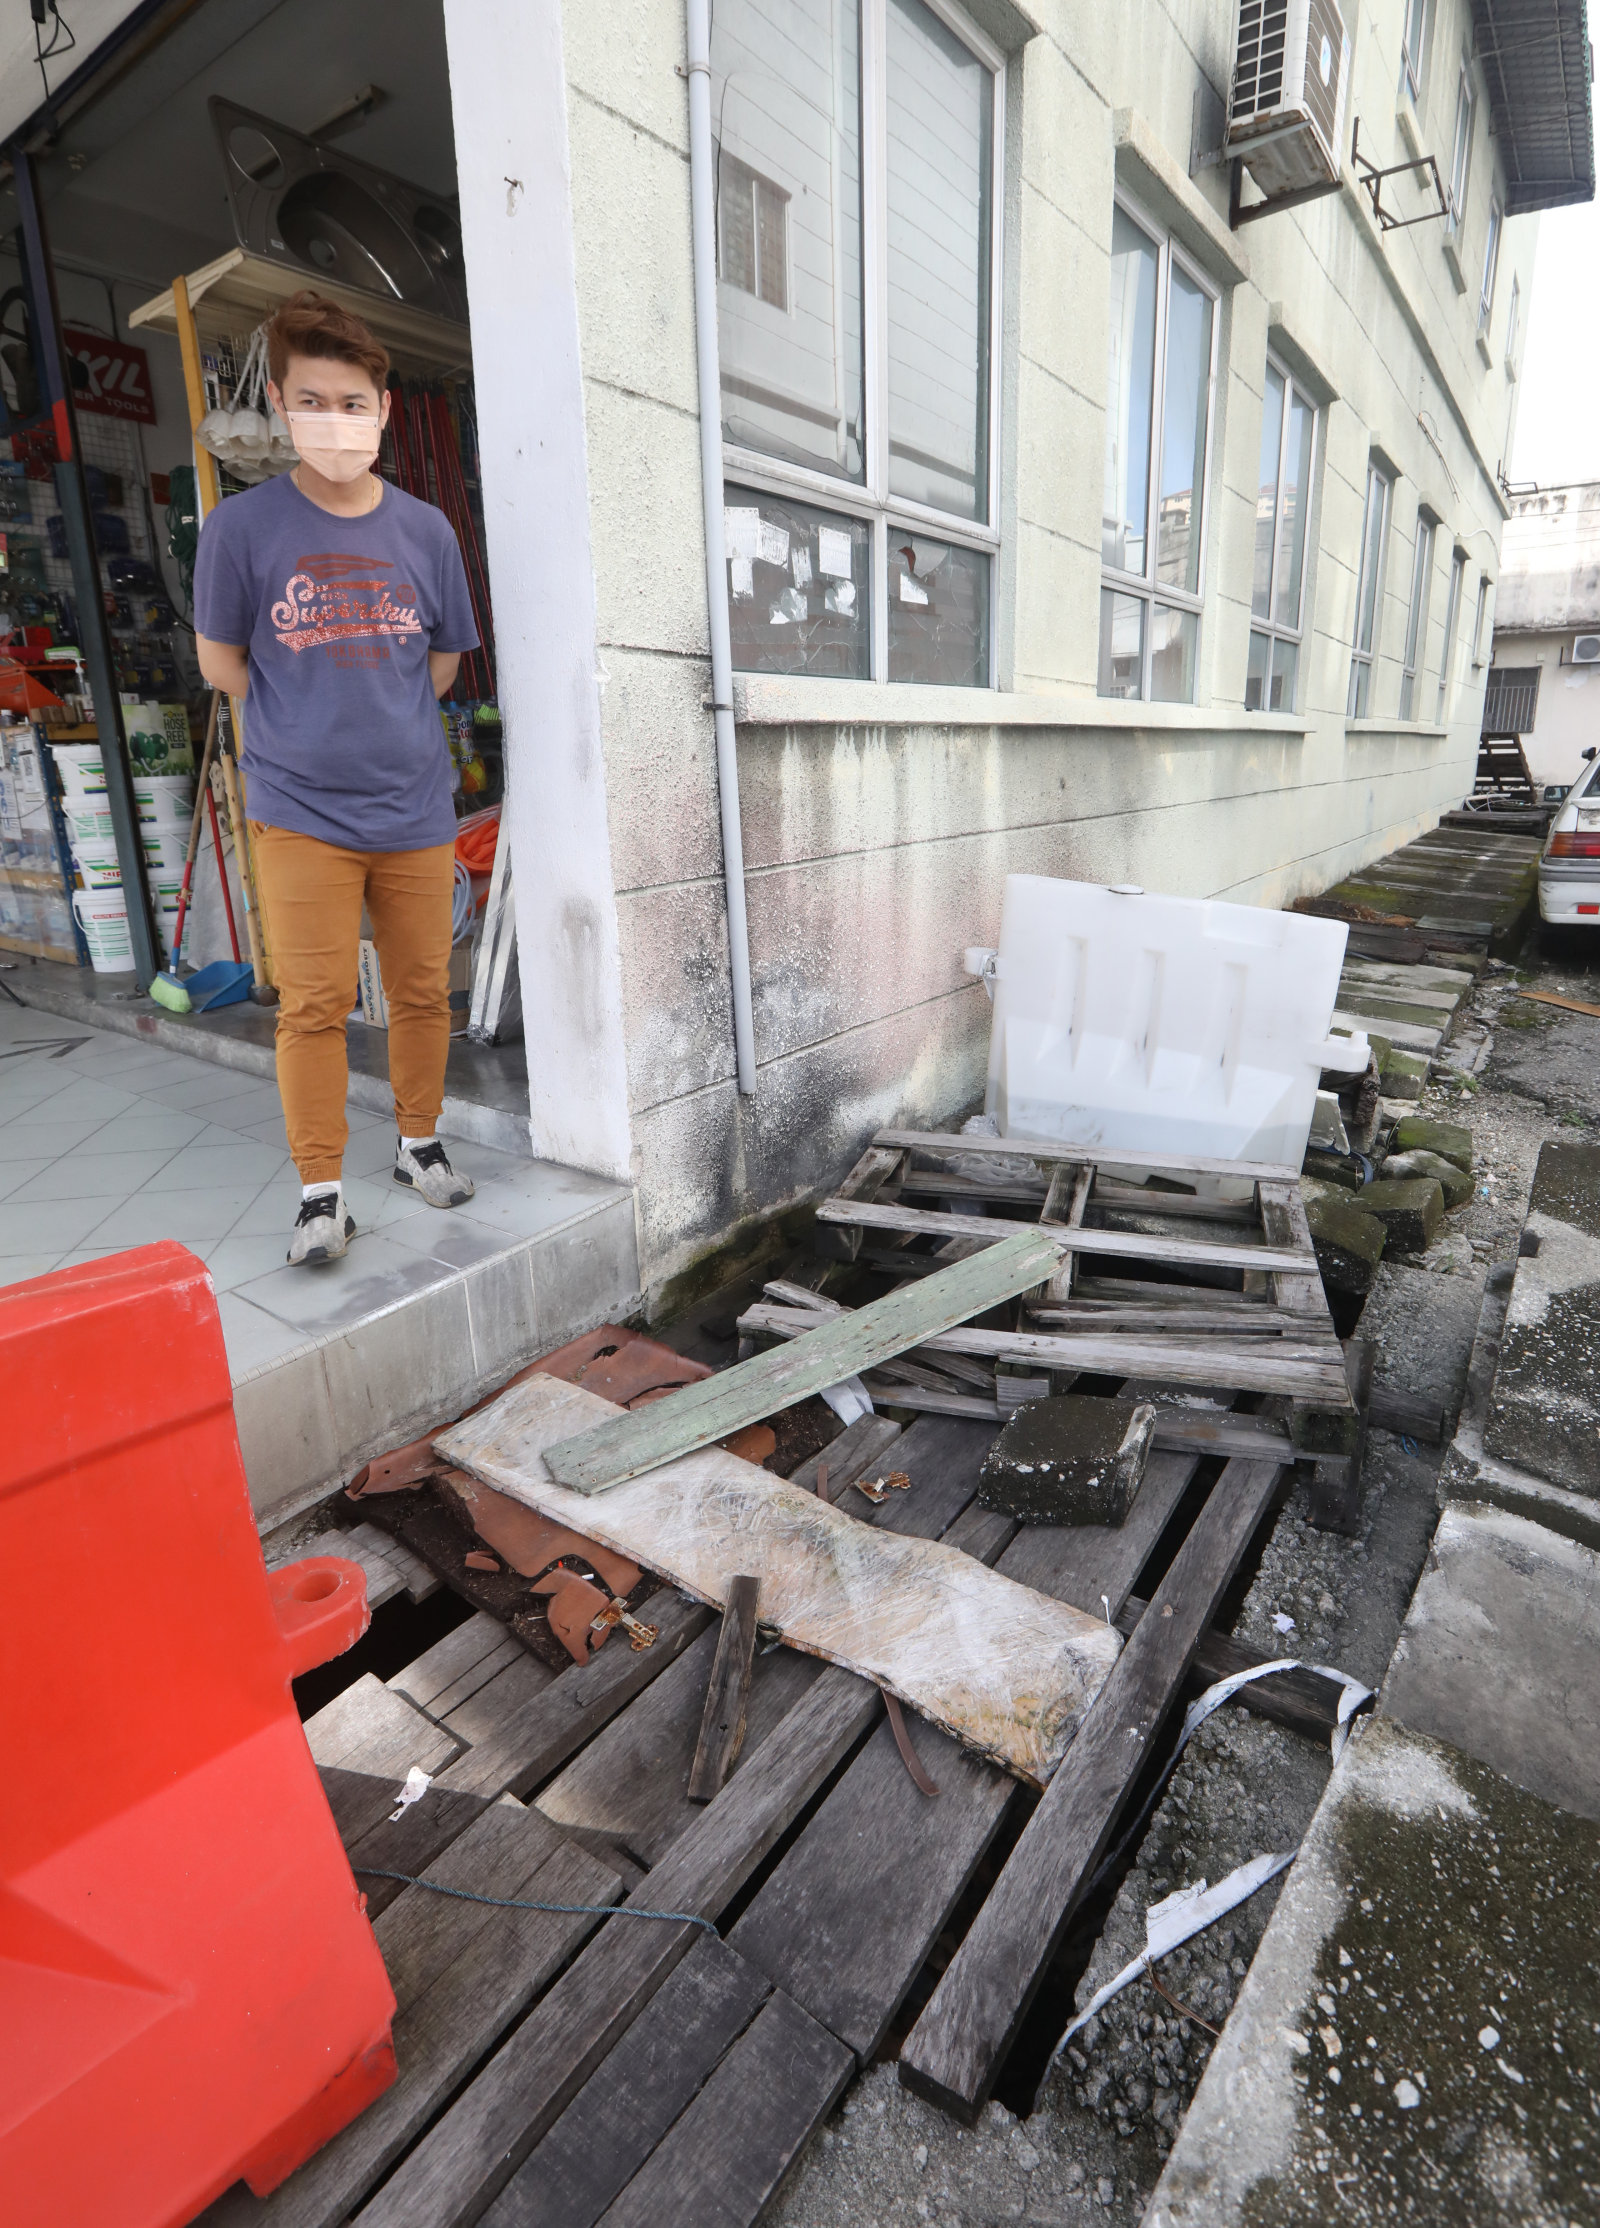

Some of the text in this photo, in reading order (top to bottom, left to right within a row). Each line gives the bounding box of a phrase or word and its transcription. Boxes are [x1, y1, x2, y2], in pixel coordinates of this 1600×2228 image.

[66, 347, 146, 397] KIL
[105, 397, 149, 413] TOOLS
[270, 574, 420, 631] Superdry
[163, 718, 187, 730] HOSE
[166, 730, 188, 742] REEL
[367, 986, 375, 1020] DAVCO
